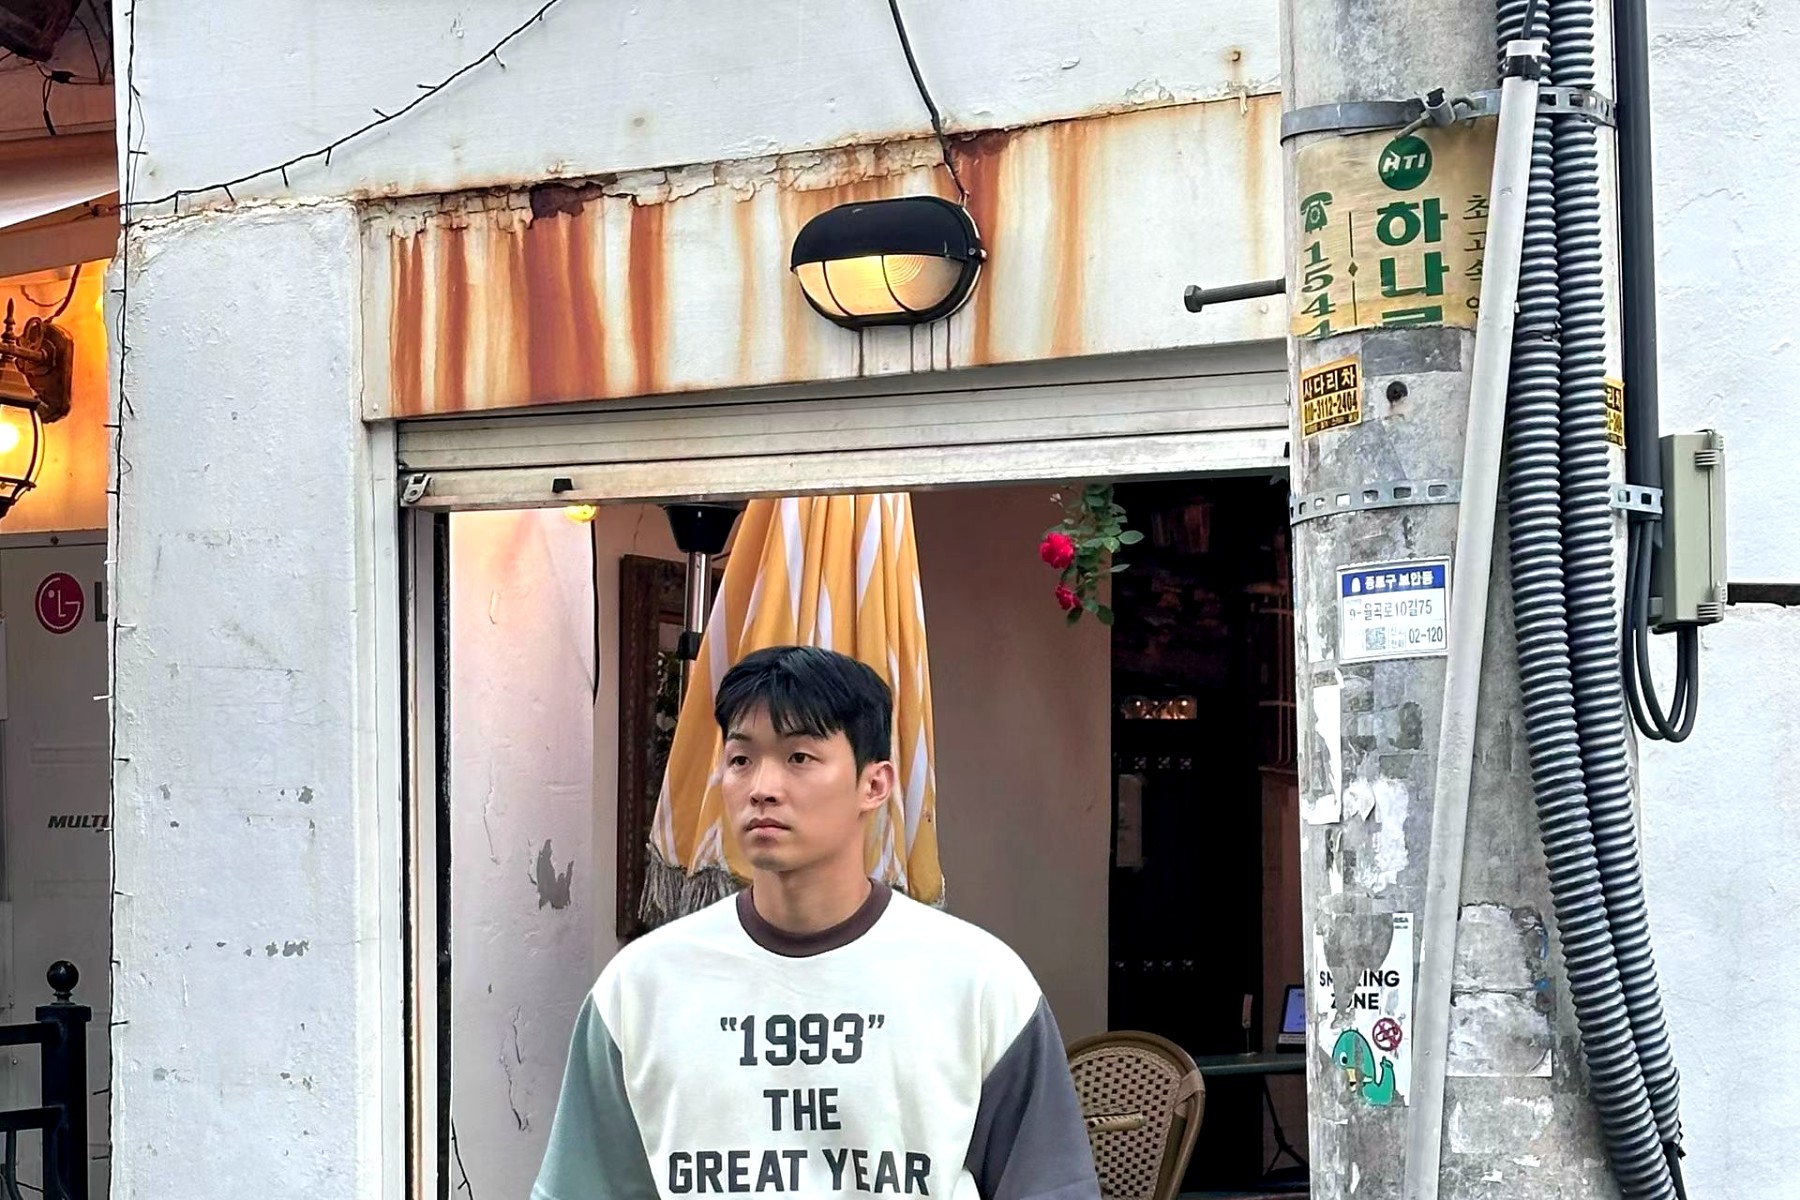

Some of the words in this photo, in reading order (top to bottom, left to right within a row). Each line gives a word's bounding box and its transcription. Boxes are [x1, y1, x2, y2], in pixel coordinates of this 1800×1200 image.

[1304, 366, 1356, 399] 사다리차
[1408, 625, 1444, 645] 02-120
[47, 814, 109, 829] MULTI
[763, 1088, 842, 1131] THE
[668, 1150, 808, 1194] GREAT
[822, 1148, 931, 1196] YEAR
